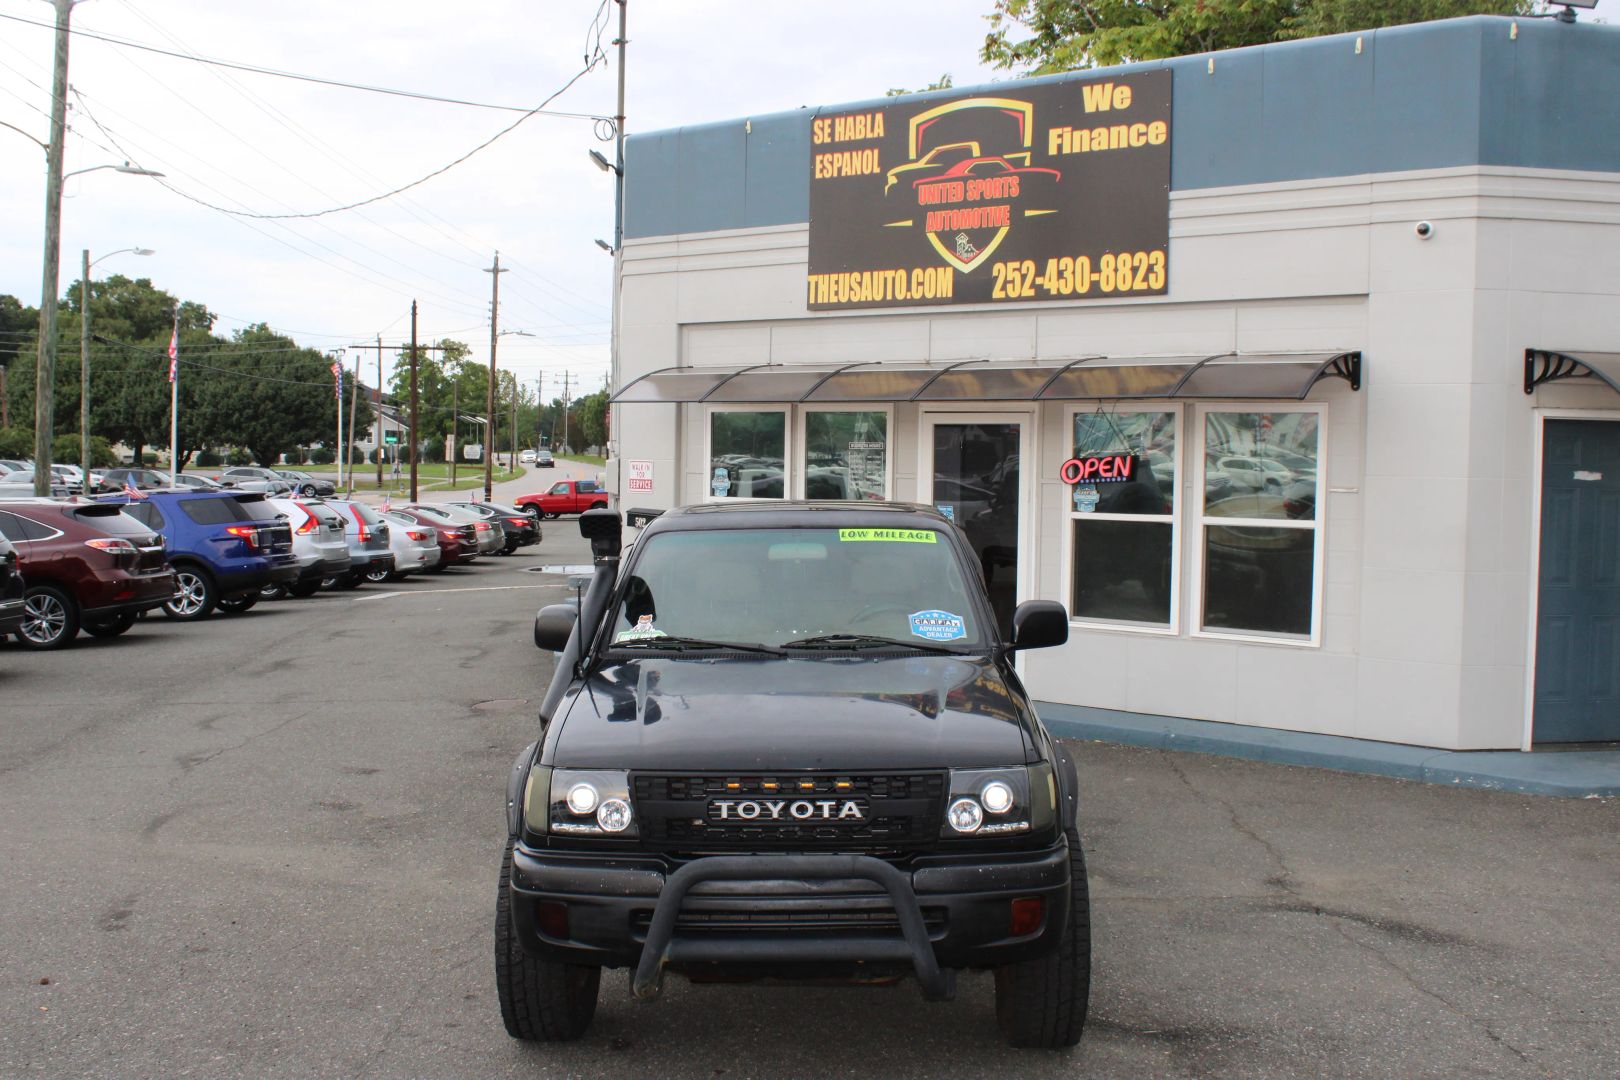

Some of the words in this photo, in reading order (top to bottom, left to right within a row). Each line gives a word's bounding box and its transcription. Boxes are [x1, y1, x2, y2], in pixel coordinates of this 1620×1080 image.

[1082, 83, 1132, 113] We
[813, 119, 832, 144] SE
[834, 112, 885, 142] HABLA
[1048, 121, 1168, 156] Finance
[815, 149, 881, 179] ESPANOL
[918, 181, 964, 205] UNITED
[966, 176, 1019, 200] SPORTS
[926, 205, 1010, 232] AUTOMOTIVE
[808, 266, 953, 304] THEUSAUTO.COM
[992, 250, 1166, 299] 252-430-8823
[630, 480, 651, 489] SERVICE
[1061, 455, 1132, 485] OPEN
[841, 530, 868, 538] LOW
[874, 531, 933, 540] MILEAGE
[914, 618, 960, 626] CARFAX
[926, 631, 953, 639] DEALER
[714, 801, 863, 819] TOYOTA
